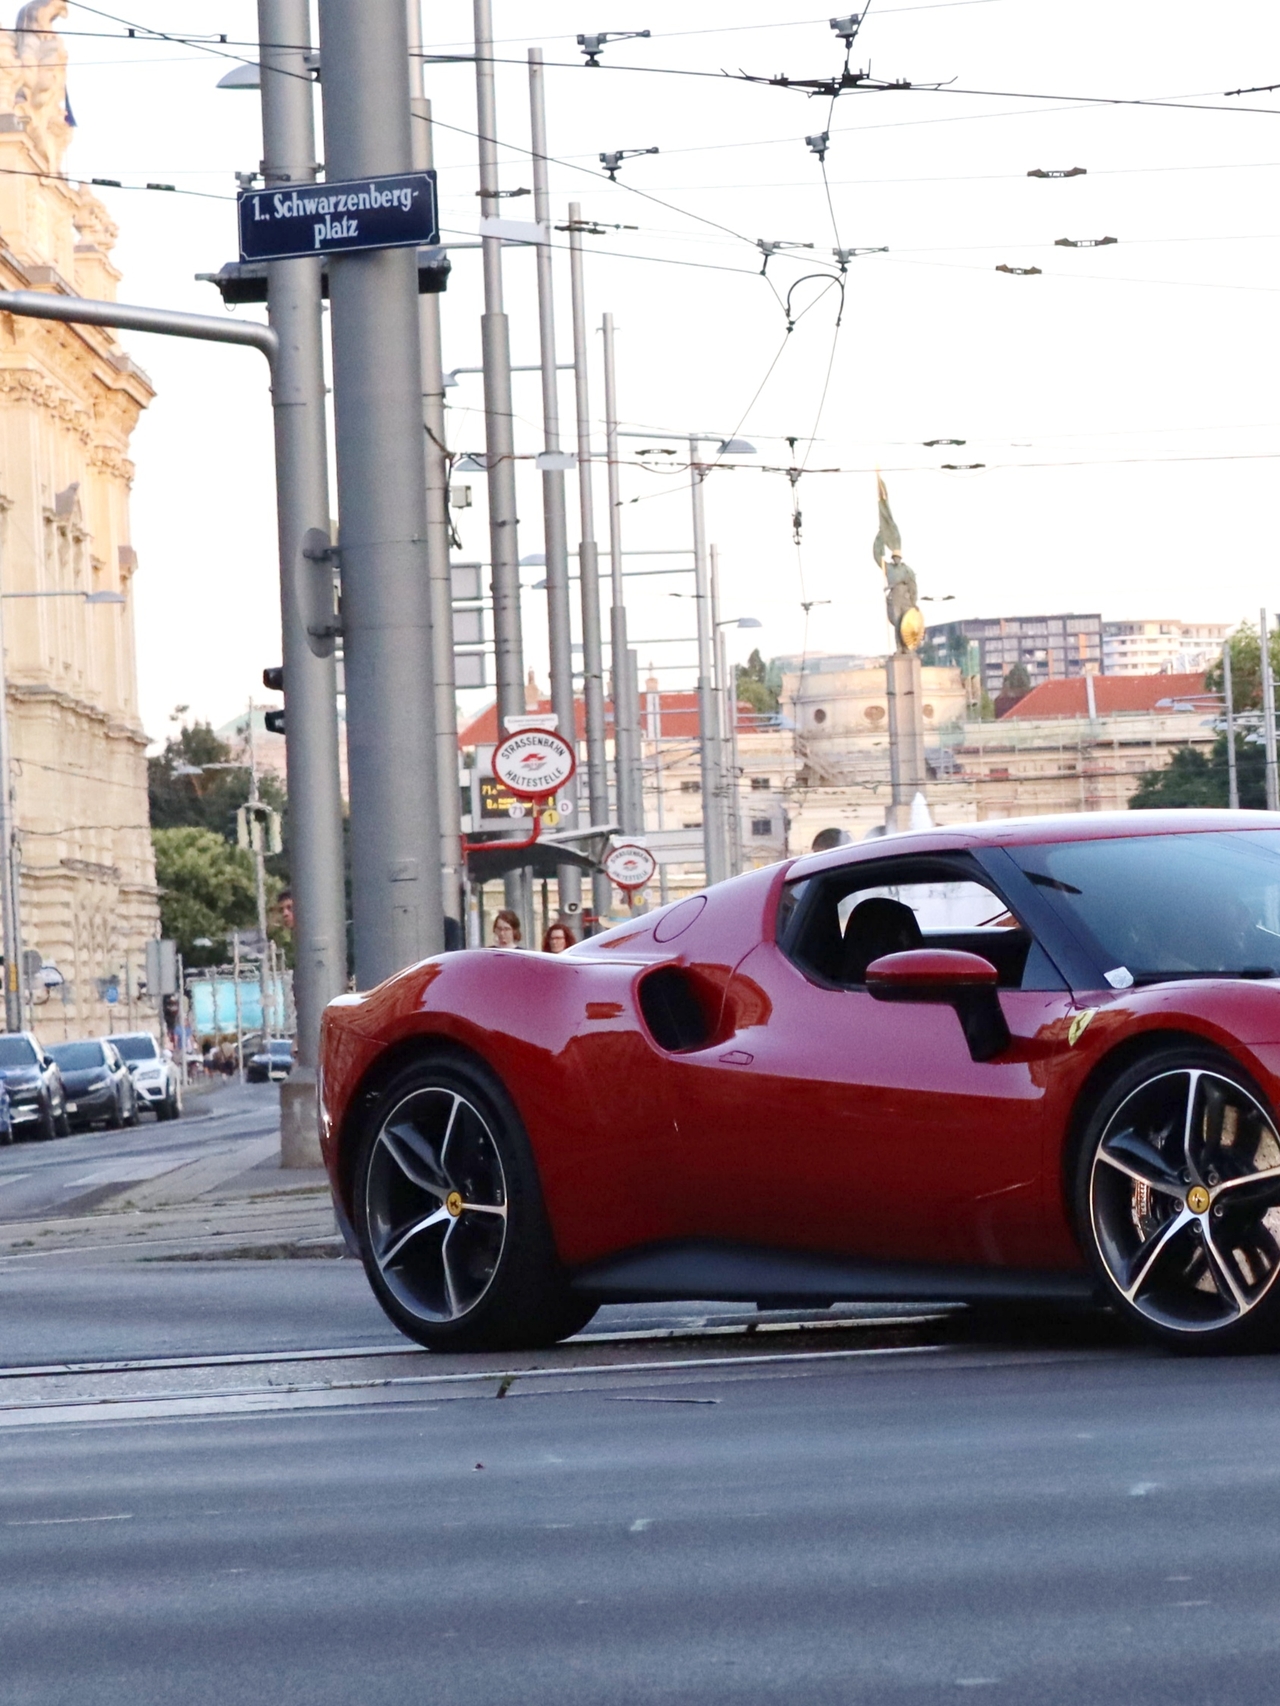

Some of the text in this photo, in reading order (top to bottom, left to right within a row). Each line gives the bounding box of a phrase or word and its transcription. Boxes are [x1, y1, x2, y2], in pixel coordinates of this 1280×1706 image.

[273, 184, 419, 219] Schwarzenberg-
[314, 215, 359, 248] platz
[501, 736, 566, 760] STRASSENBAHN
[505, 767, 564, 788] HALTESTELLE
[548, 812, 553, 823] 1
[561, 803, 569, 812] D
